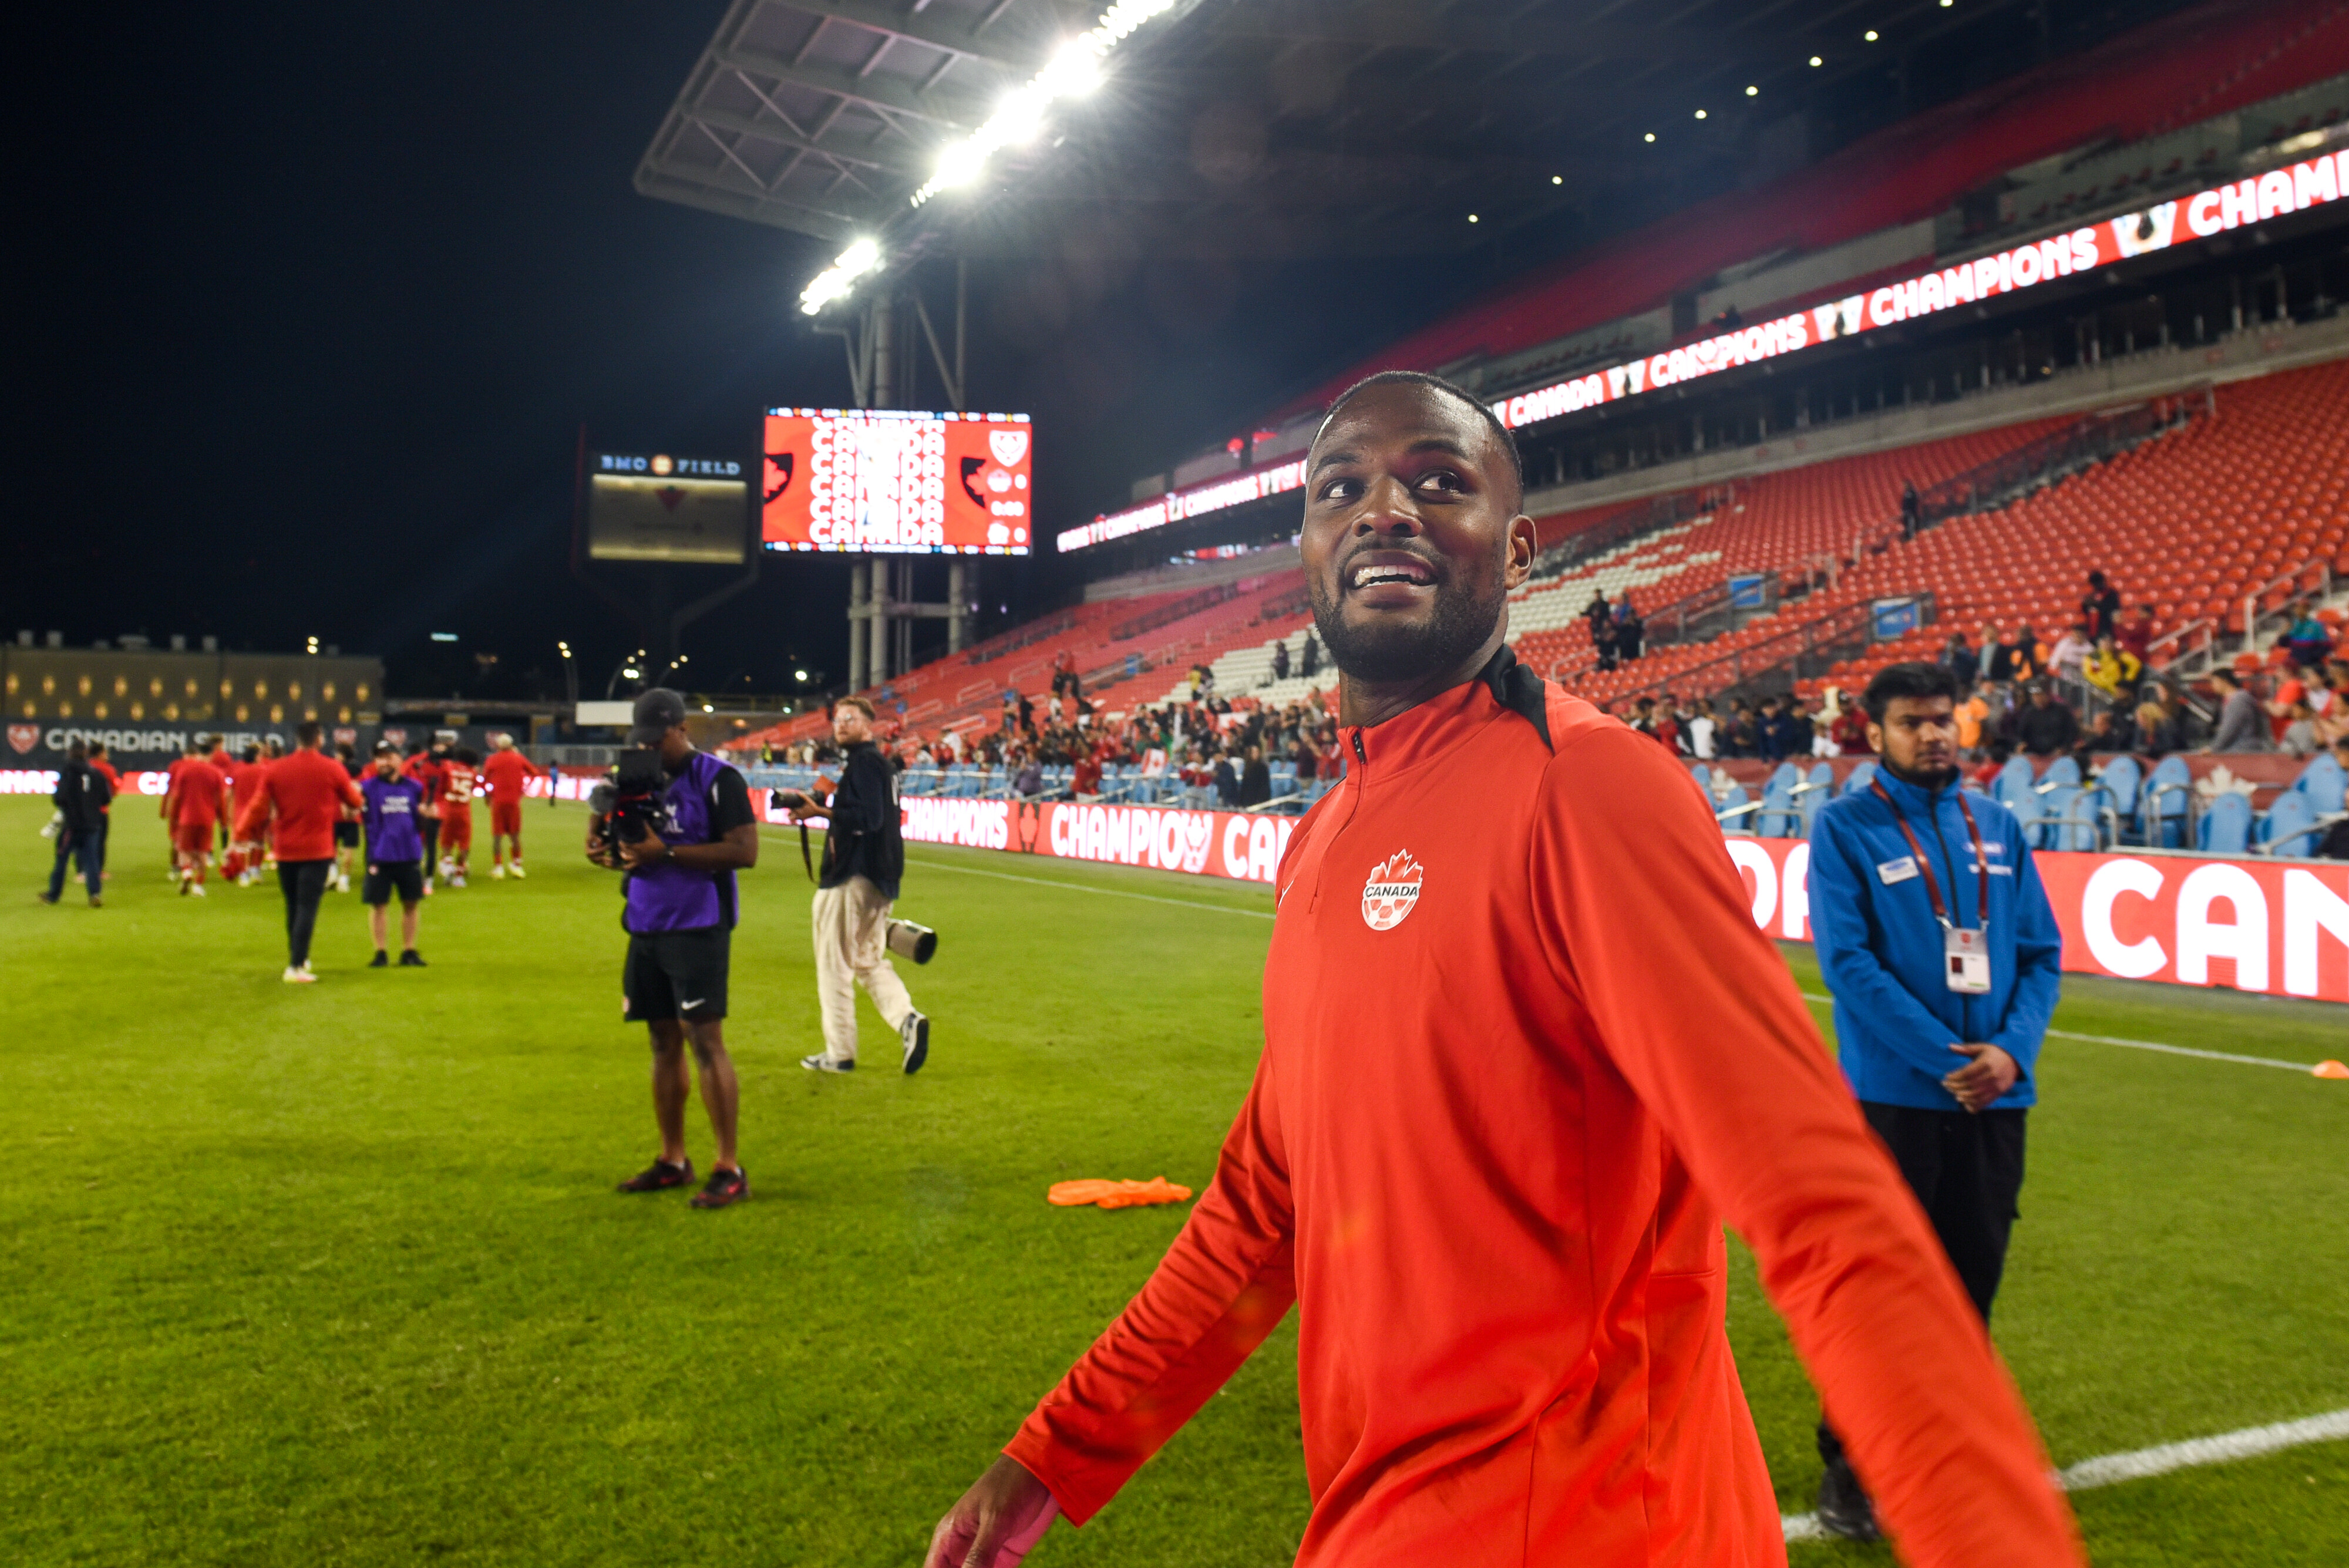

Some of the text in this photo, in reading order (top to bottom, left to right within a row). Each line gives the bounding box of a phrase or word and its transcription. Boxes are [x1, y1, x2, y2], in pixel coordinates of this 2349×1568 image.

[1508, 374, 1603, 426] CANADA
[1869, 227, 2099, 326] CHAMPIONS
[601, 455, 741, 475] BMO FIELD
[45, 728, 186, 752] CANADIAN
[1365, 886, 1418, 897] CANADA
[2082, 859, 2349, 997] CAN
